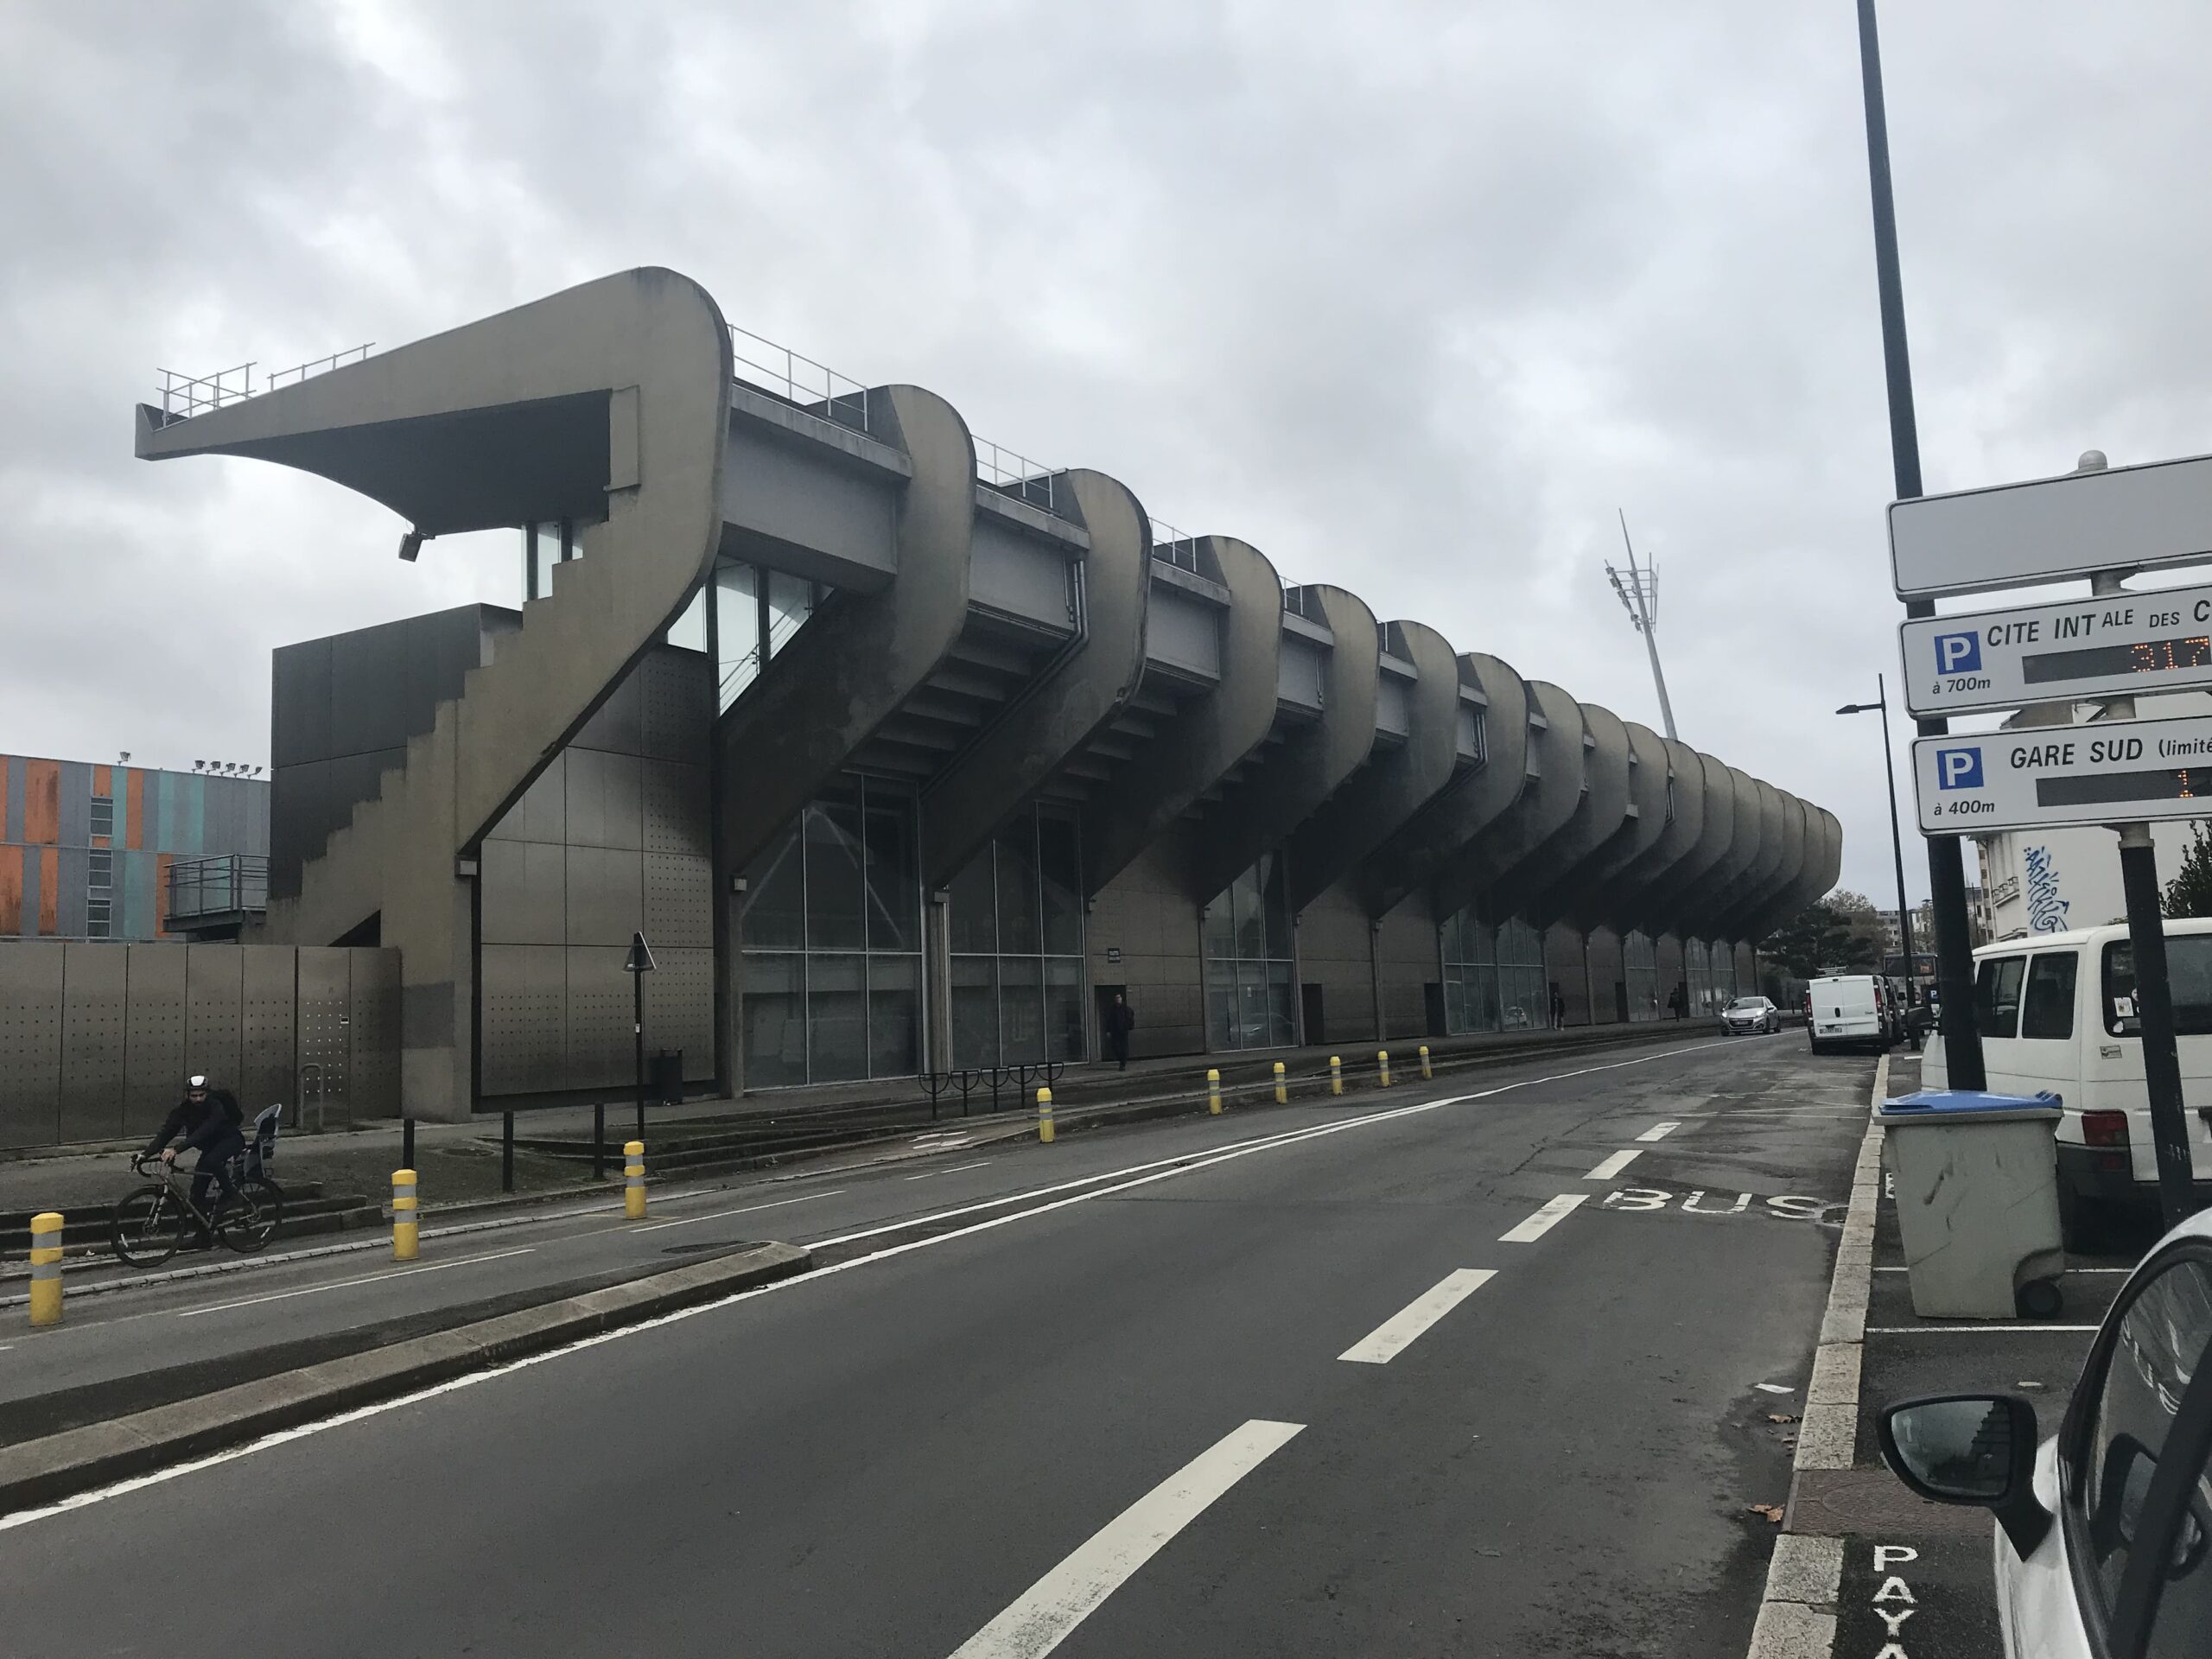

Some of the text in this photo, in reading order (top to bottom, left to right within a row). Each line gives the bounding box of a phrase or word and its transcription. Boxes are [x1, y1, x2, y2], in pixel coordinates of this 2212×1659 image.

[1986, 620, 2040, 647] CITE
[2149, 611, 2181, 628] DES
[1942, 636, 1972, 671] P
[2131, 638, 2209, 673] 317
[1932, 677, 1992, 695] à 700m
[1944, 752, 1974, 787] P
[2010, 743, 2075, 769] GARE
[2089, 738, 2144, 764] SUD
[1934, 800, 1996, 816] à 400m
[1604, 1188, 1832, 1219] BUS
